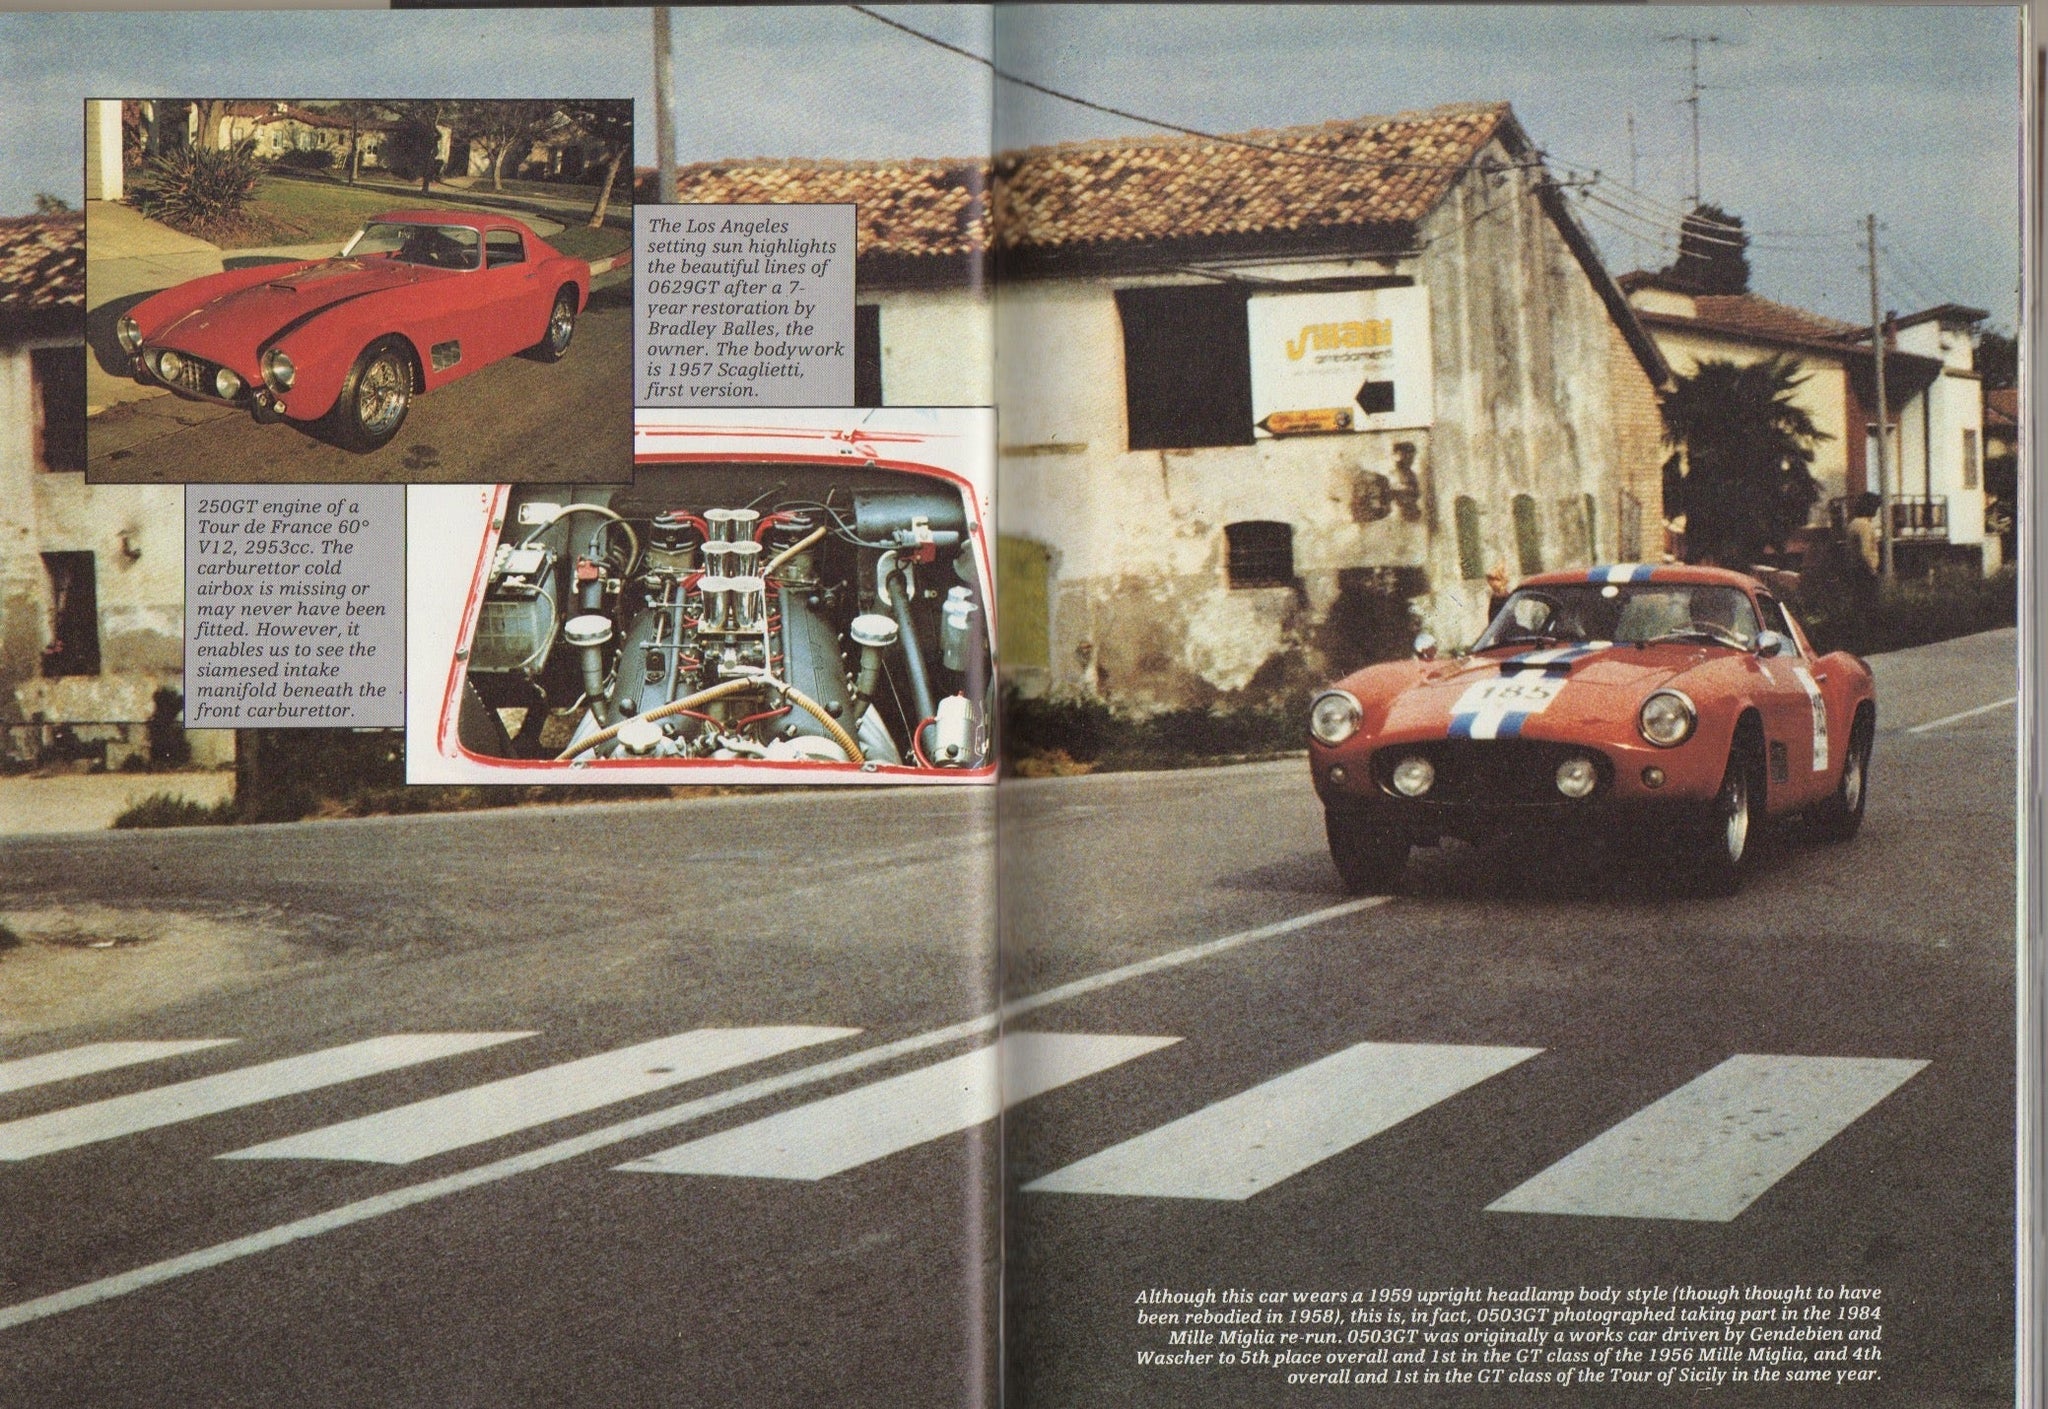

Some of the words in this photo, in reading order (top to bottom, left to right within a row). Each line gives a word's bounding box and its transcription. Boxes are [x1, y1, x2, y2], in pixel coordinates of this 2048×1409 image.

[649, 217, 682, 233] The
[686, 219, 716, 233] Los
[720, 218, 789, 237] Angeles
[647, 238, 706, 257] setting
[712, 242, 743, 254] sun
[748, 238, 836, 258] highlights
[648, 258, 676, 274] the
[681, 258, 760, 278] beautiful
[764, 258, 806, 274] lines
[811, 259, 831, 278] of
[648, 280, 721, 294] 0629GT
[724, 279, 767, 298] after
[771, 284, 782, 294] a
[790, 280, 805, 294] 7-
[648, 304, 688, 319] year
[692, 300, 789, 315] restoration
[794, 300, 816, 319] by
[648, 320, 717, 339] Bradley
[722, 320, 779, 337] Balles,
[786, 320, 814, 336] the
[647, 345, 708, 356] owner.
[717, 341, 749, 356] The
[754, 341, 845, 360] bodywork
[647, 361, 661, 376] is
[669, 362, 713, 377] 1957
[717, 361, 804, 381] Scaglietti,
[644, 381, 683, 400] first
[690, 382, 758, 397] version.
[198, 499, 259, 514] 250GT
[262, 499, 322, 518] engine
[326, 498, 347, 517] of
[348, 503, 359, 514] a
[198, 519, 240, 534] Tour
[244, 518, 266, 534] de
[271, 519, 332, 534] France
[199, 540, 237, 556] V12,
[244, 540, 314, 555] 2953cc.
[321, 539, 354, 554] The
[197, 559, 300, 575] carburettor
[304, 559, 342, 575] cold
[197, 580, 254, 596] airbox
[259, 581, 274, 596] is
[279, 581, 347, 600] missing
[351, 585, 370, 595] or
[197, 605, 235, 620] may
[241, 605, 292, 616] never
[297, 601, 340, 616] have
[345, 601, 385, 616] been
[194, 621, 248, 640] fitted.
[256, 622, 341, 638] However,
[348, 621, 359, 636] it
[197, 641, 264, 657] enables
[269, 646, 289, 657] us
[295, 644, 311, 657] to
[316, 646, 344, 657] see
[349, 641, 376, 657] the
[197, 662, 279, 677] siamesed
[284, 662, 340, 677] intake
[197, 682, 277, 701] manifold
[283, 682, 353, 697] beneath
[359, 682, 386, 697] the
[194, 702, 240, 720] front
[247, 702, 354, 717] carburettor.
[1135, 1288, 1216, 1308] Although
[1222, 1288, 1254, 1303] this
[1259, 1292, 1288, 1303] car
[1293, 1292, 1348, 1303] wears
[1351, 1292, 1363, 1303] a
[1370, 1288, 1413, 1302] 1959
[1418, 1287, 1481, 1306] upright
[1487, 1286, 1574, 1305] headlamp
[1579, 1286, 1621, 1304] body
[1627, 1286, 1668, 1304] style
[1673, 1285, 1739, 1304] (though
[1745, 1285, 1811, 1304] thought
[1817, 1287, 1834, 1299] to
[1839, 1284, 1882, 1299] have
[1137, 1309, 1179, 1324] been
[1185, 1309, 1262, 1324] rebodied
[1266, 1309, 1283, 1323] in
[1290, 1309, 1344, 1325] 1958),
[1351, 1308, 1382, 1323] this
[1387, 1308, 1405, 1324] is,
[1411, 1308, 1428, 1323] in
[1429, 1307, 1471, 1327] fact,
[1477, 1308, 1550, 1322] 0503GT
[1552, 1306, 1676, 1325] photographed
[1681, 1306, 1736, 1325] taking
[1739, 1308, 1776, 1324] part
[1782, 1306, 1797, 1320] in
[1803, 1305, 1831, 1320] the
[1839, 1306, 1881, 1320] 1984
[1169, 1329, 1214, 1345] Mille
[1219, 1329, 1274, 1348] Miglia
[1280, 1333, 1342, 1344] re-run.
[1347, 1329, 1419, 1343] 0503GT
[1424, 1332, 1459, 1343] was
[1464, 1327, 1549, 1347] originally
[1554, 1332, 1564, 1342] a
[1570, 1327, 1623, 1342] works
[1628, 1331, 1657, 1342] car
[1662, 1327, 1719, 1342] driven
[1724, 1326, 1745, 1345] by
[1750, 1326, 1843, 1341] Gendebien
[1848, 1325, 1882, 1340] and
[1137, 1350, 1213, 1365] Wascher
[1219, 1352, 1235, 1364] to
[1240, 1349, 1269, 1364] 5th
[1273, 1349, 1321, 1368] place
[1326, 1349, 1388, 1364] overall
[1392, 1348, 1426, 1363] and
[1432, 1350, 1456, 1363] 1st
[1461, 1348, 1477, 1363] in
[1484, 1348, 1511, 1362] the
[1516, 1349, 1543, 1363] GT
[1547, 1348, 1589, 1362] class
[1594, 1347, 1613, 1366] of
[1616, 1347, 1643, 1362] the
[1650, 1348, 1693, 1362] 1956
[1698, 1347, 1743, 1361] Mille
[1748, 1346, 1807, 1365] Miglia,
[1814, 1346, 1847, 1361] and
[1852, 1346, 1881, 1360] 4th
[1287, 1368, 1351, 1384] overall
[1354, 1368, 1388, 1384] and
[1394, 1370, 1418, 1383] 1st
[1424, 1368, 1440, 1383] in
[1445, 1368, 1473, 1383] the
[1478, 1369, 1505, 1383] GT
[1508, 1368, 1552, 1383] class
[1556, 1367, 1576, 1387] of
[1578, 1367, 1605, 1382] the
[1610, 1368, 1652, 1382] Tour
[1657, 1367, 1677, 1386] of
[1679, 1366, 1727, 1385] Sicily
[1732, 1367, 1748, 1381] in
[1754, 1366, 1780, 1381] the
[1785, 1370, 1831, 1381] same
[1837, 1370, 1881, 1385] year.
